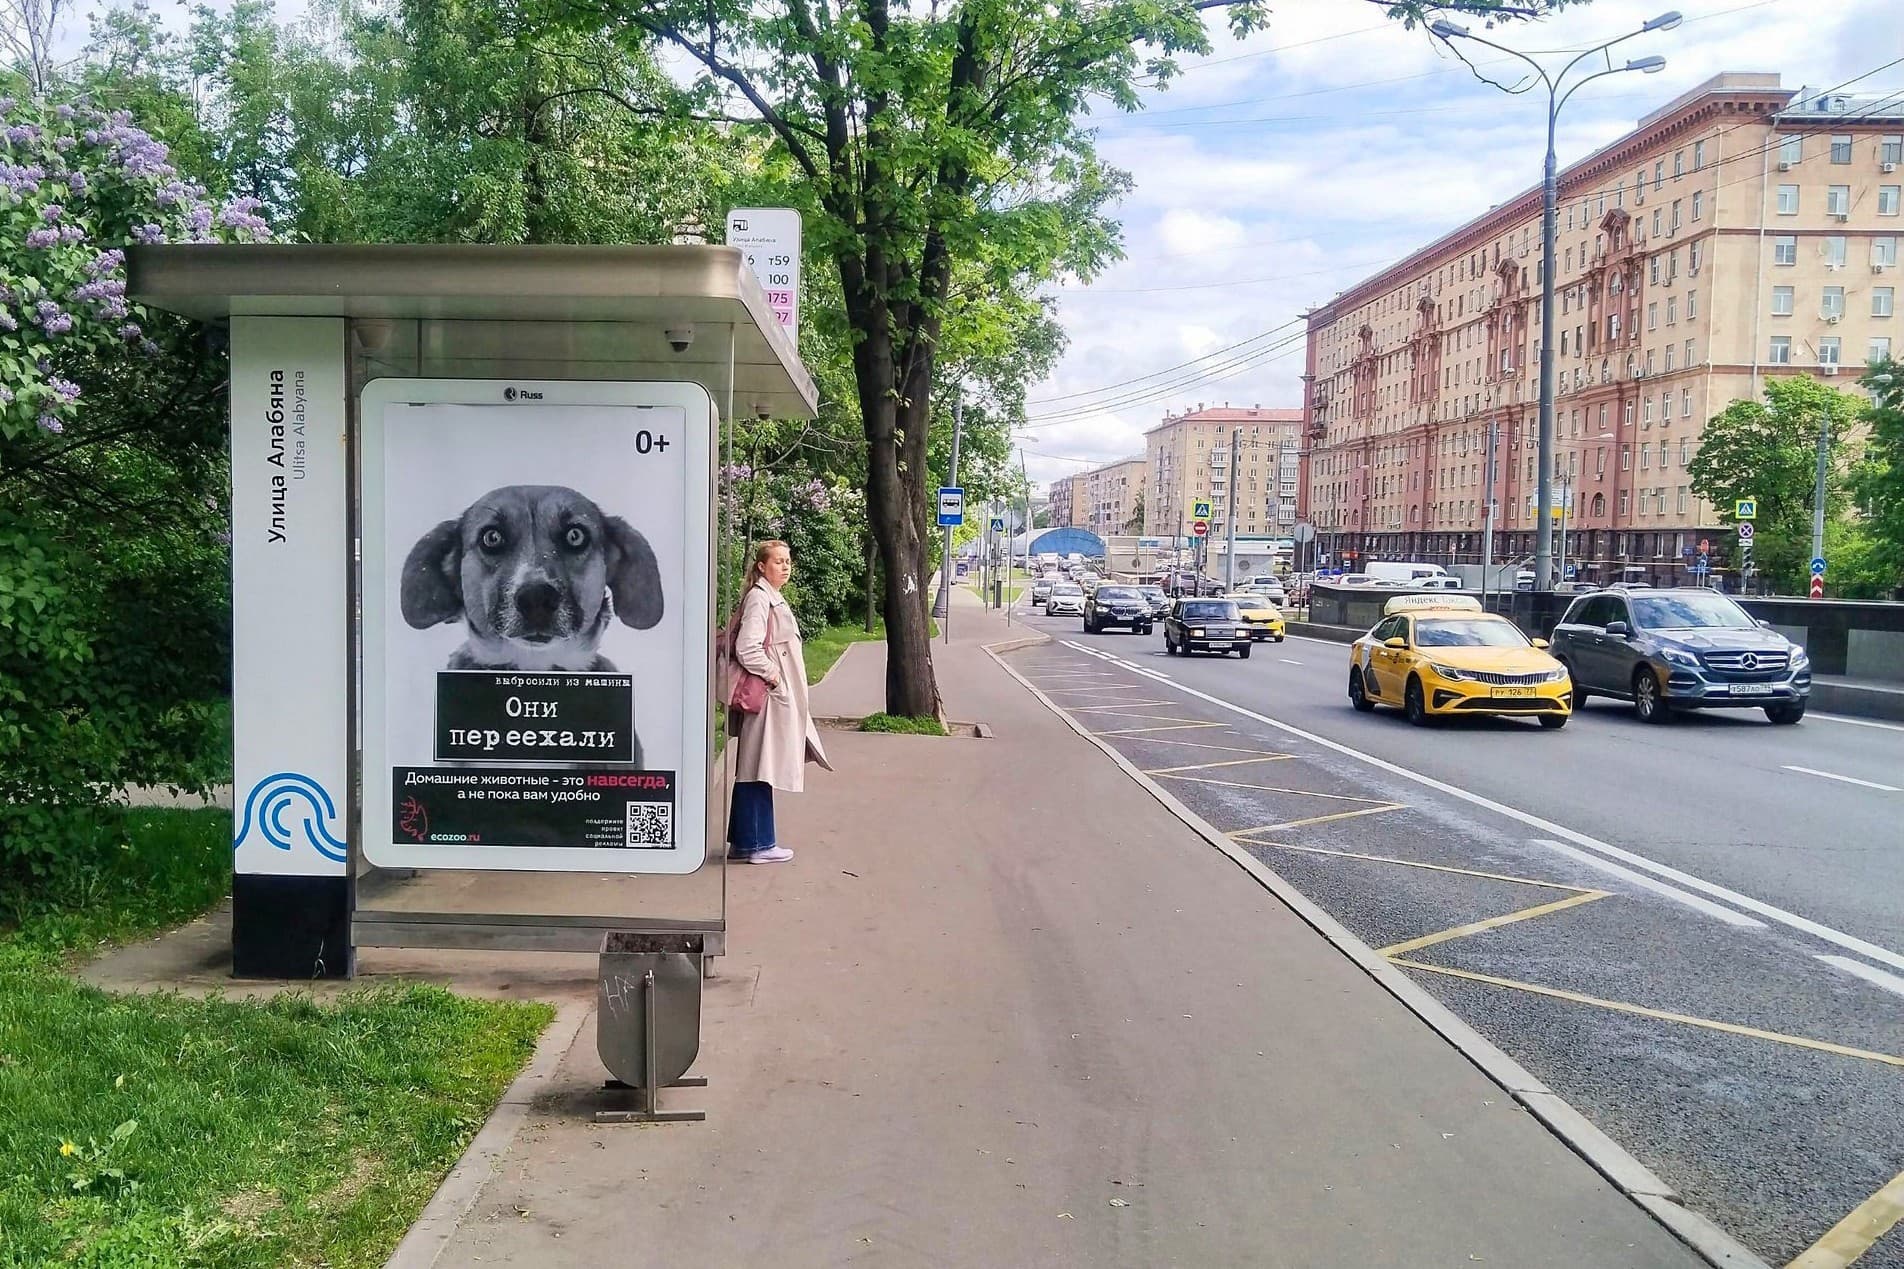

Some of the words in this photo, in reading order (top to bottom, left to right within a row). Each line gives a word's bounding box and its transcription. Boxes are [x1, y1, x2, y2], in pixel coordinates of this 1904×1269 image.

[768, 274, 789, 285] 100
[767, 293, 788, 304] 175
[292, 370, 307, 437] Alabyana
[520, 390, 544, 400] Russ
[265, 370, 285, 468] Алабяна
[635, 430, 670, 454] 0+
[292, 441, 306, 480] Ulitsa
[267, 475, 288, 543] Улица
[495, 676, 560, 687] выбросили
[566, 677, 580, 687] из
[585, 678, 631, 688] машины
[505, 696, 558, 719] Они
[449, 728, 616, 750] переехали
[404, 771, 478, 786] Домашние
[480, 775, 549, 786] животные
[561, 776, 584, 786] это
[586, 775, 670, 789] навсегда,
[457, 790, 466, 799] а
[468, 790, 485, 799] не
[487, 790, 520, 800] пока
[523, 791, 548, 800] вам
[550, 789, 601, 803] удобно
[430, 833, 481, 842] ecozoo.ru
